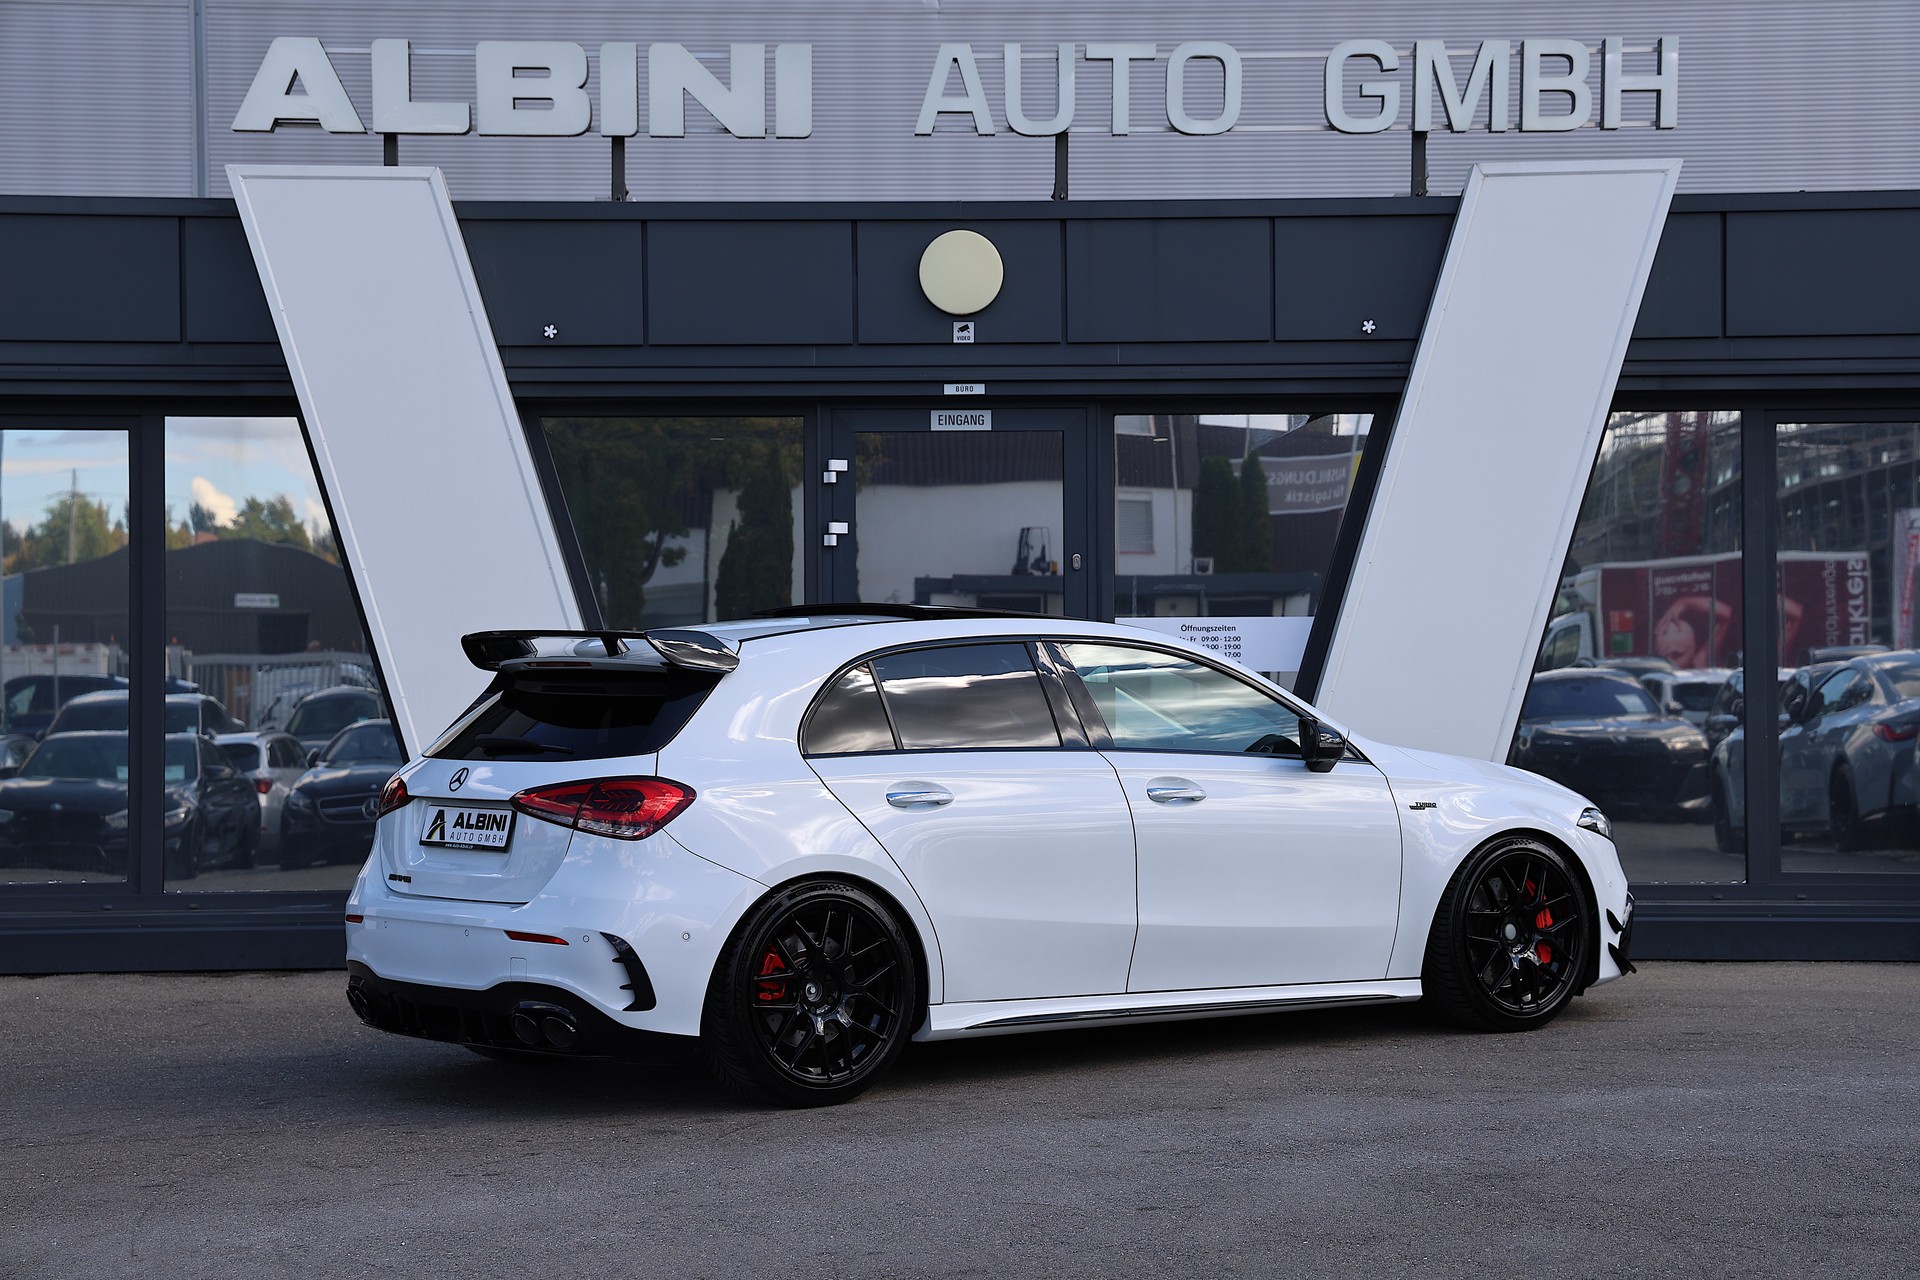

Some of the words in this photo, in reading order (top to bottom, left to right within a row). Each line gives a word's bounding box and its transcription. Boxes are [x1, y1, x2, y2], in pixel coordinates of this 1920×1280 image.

[231, 36, 813, 139] ALBINI
[914, 40, 1242, 138] AUTO
[1324, 35, 1680, 135] GMBH
[955, 384, 974, 392] BÜRO
[938, 414, 985, 426] EINGANG
[1180, 624, 1236, 633] Öffnungszeiten
[452, 812, 508, 832] ALBINI
[450, 832, 474, 842] AUTO
[477, 833, 505, 844] GMBH
